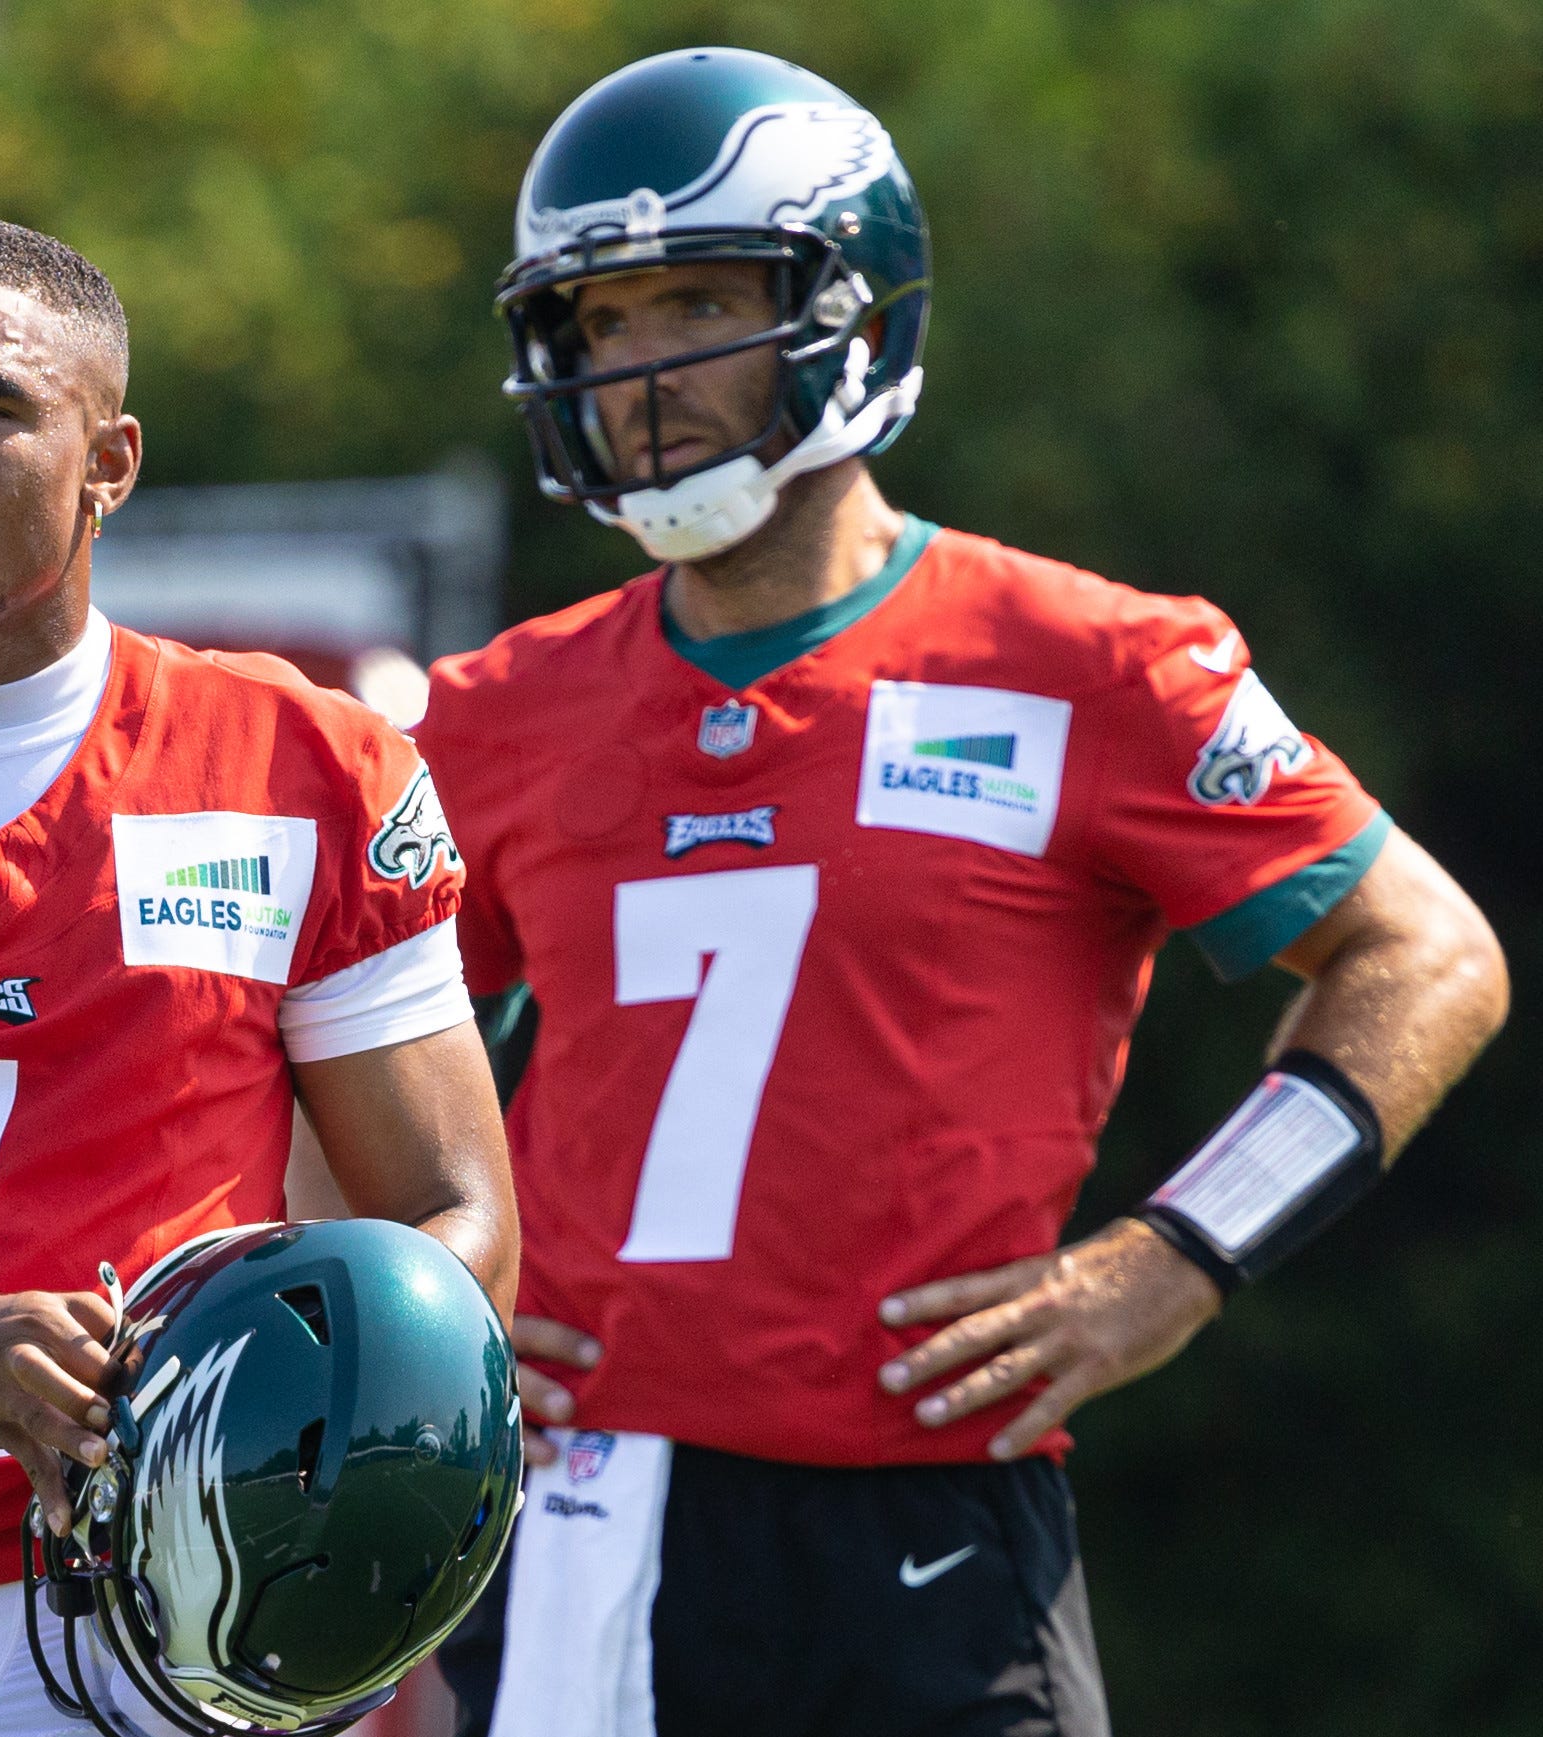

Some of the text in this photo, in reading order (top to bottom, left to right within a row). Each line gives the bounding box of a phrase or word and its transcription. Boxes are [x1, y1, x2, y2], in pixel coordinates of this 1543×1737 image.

[882, 762, 981, 800] EAGLES
[139, 897, 292, 931] EAGLES AUTISM
[244, 926, 287, 940] FOUNDATION
[614, 863, 819, 1263] 7
